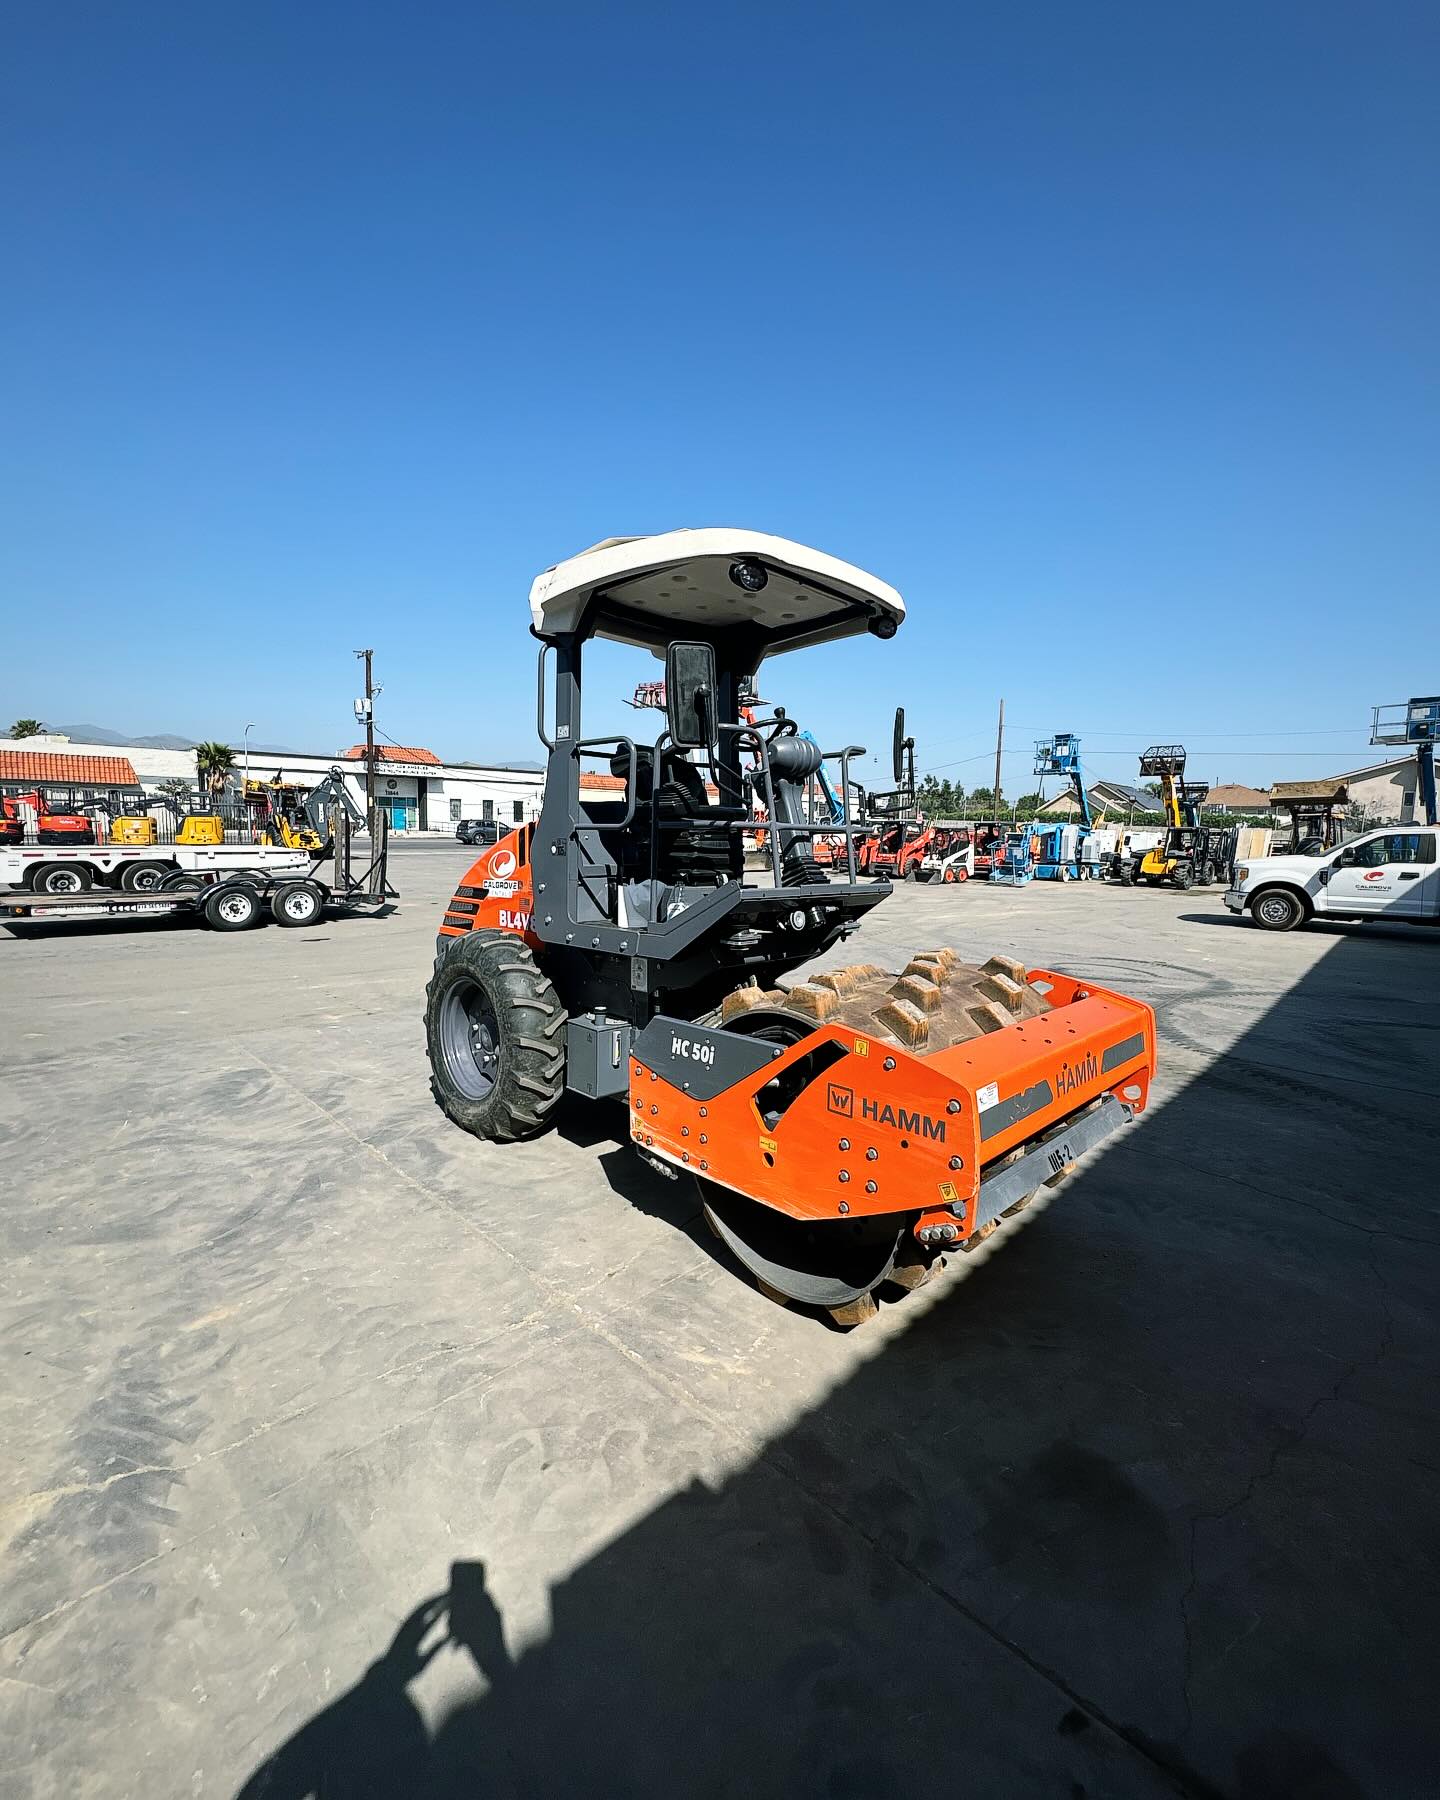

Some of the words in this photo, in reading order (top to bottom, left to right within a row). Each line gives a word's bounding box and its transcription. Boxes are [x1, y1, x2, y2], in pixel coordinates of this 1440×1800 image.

[483, 880, 518, 890] CALGROVE
[671, 1037, 691, 1058] HC
[691, 1042, 715, 1065] 50i
[1055, 1055, 1098, 1098] HAMM
[862, 1097, 946, 1143] HAMM
